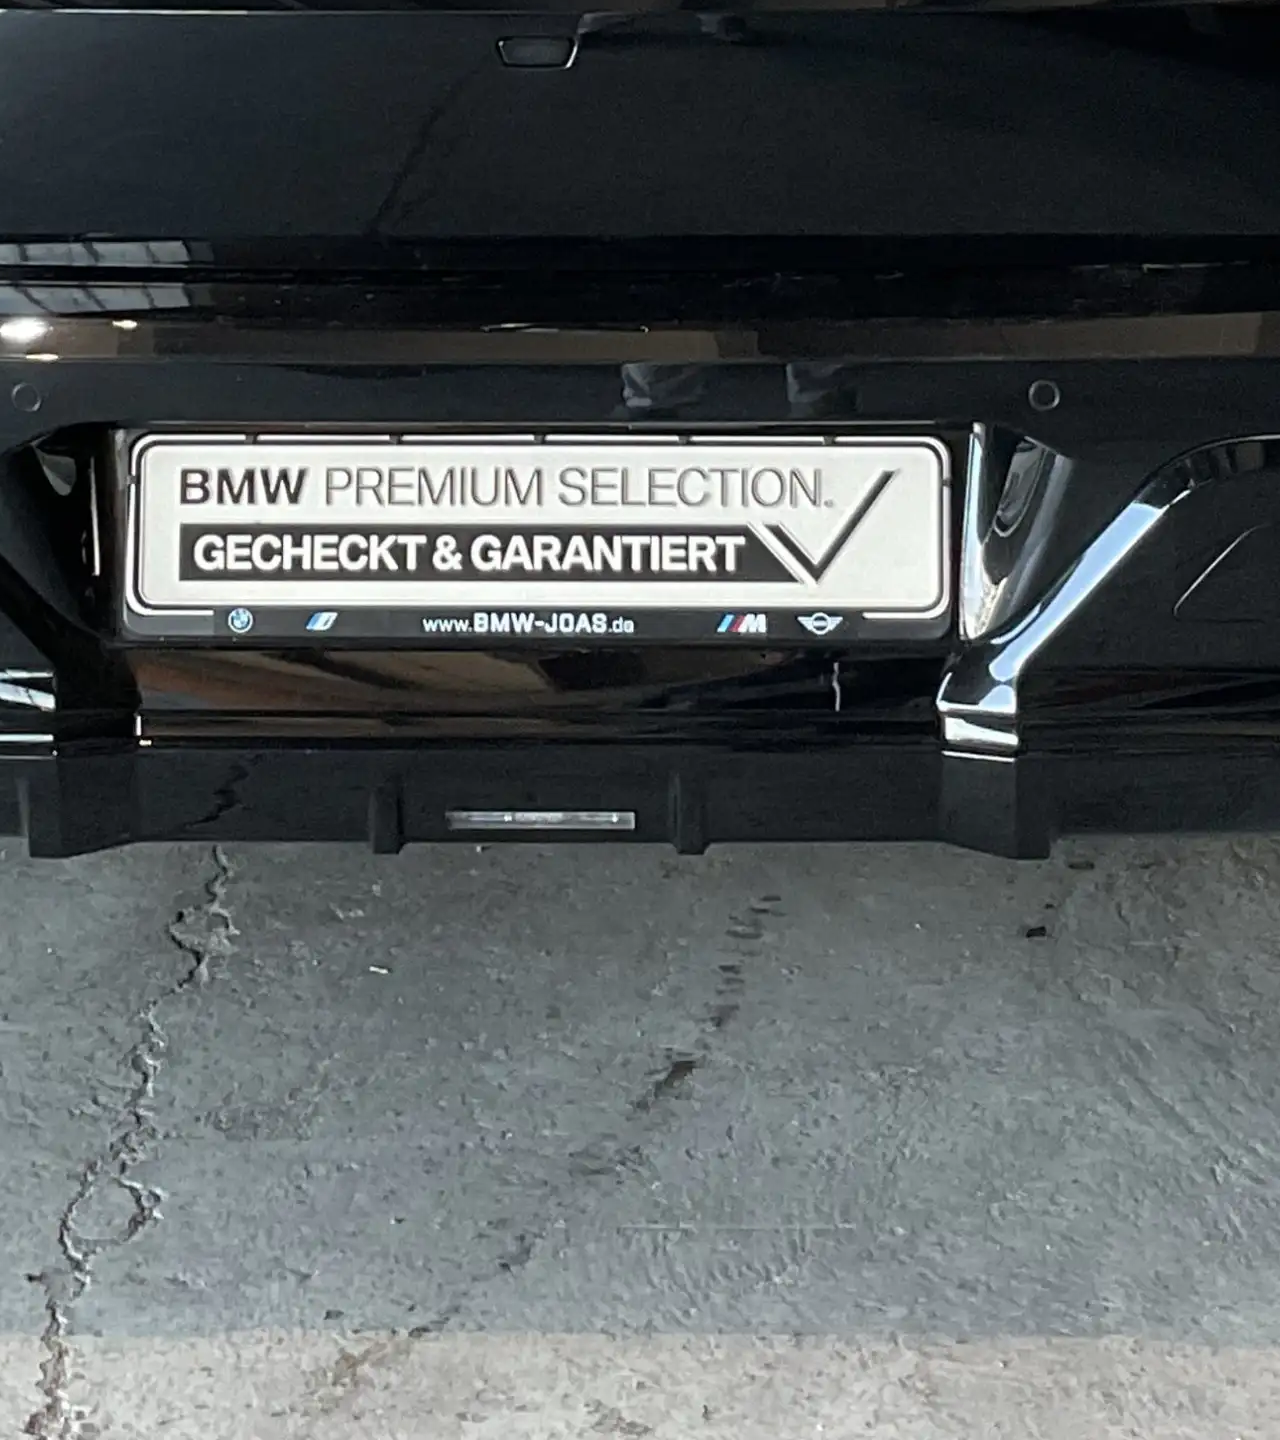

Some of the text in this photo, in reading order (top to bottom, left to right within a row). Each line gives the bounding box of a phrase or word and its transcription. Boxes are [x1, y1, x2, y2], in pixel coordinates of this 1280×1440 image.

[180, 467, 308, 505] BMW
[325, 467, 544, 506] PREMIUM
[193, 533, 746, 572] GECHECKT & GARANTIERT
